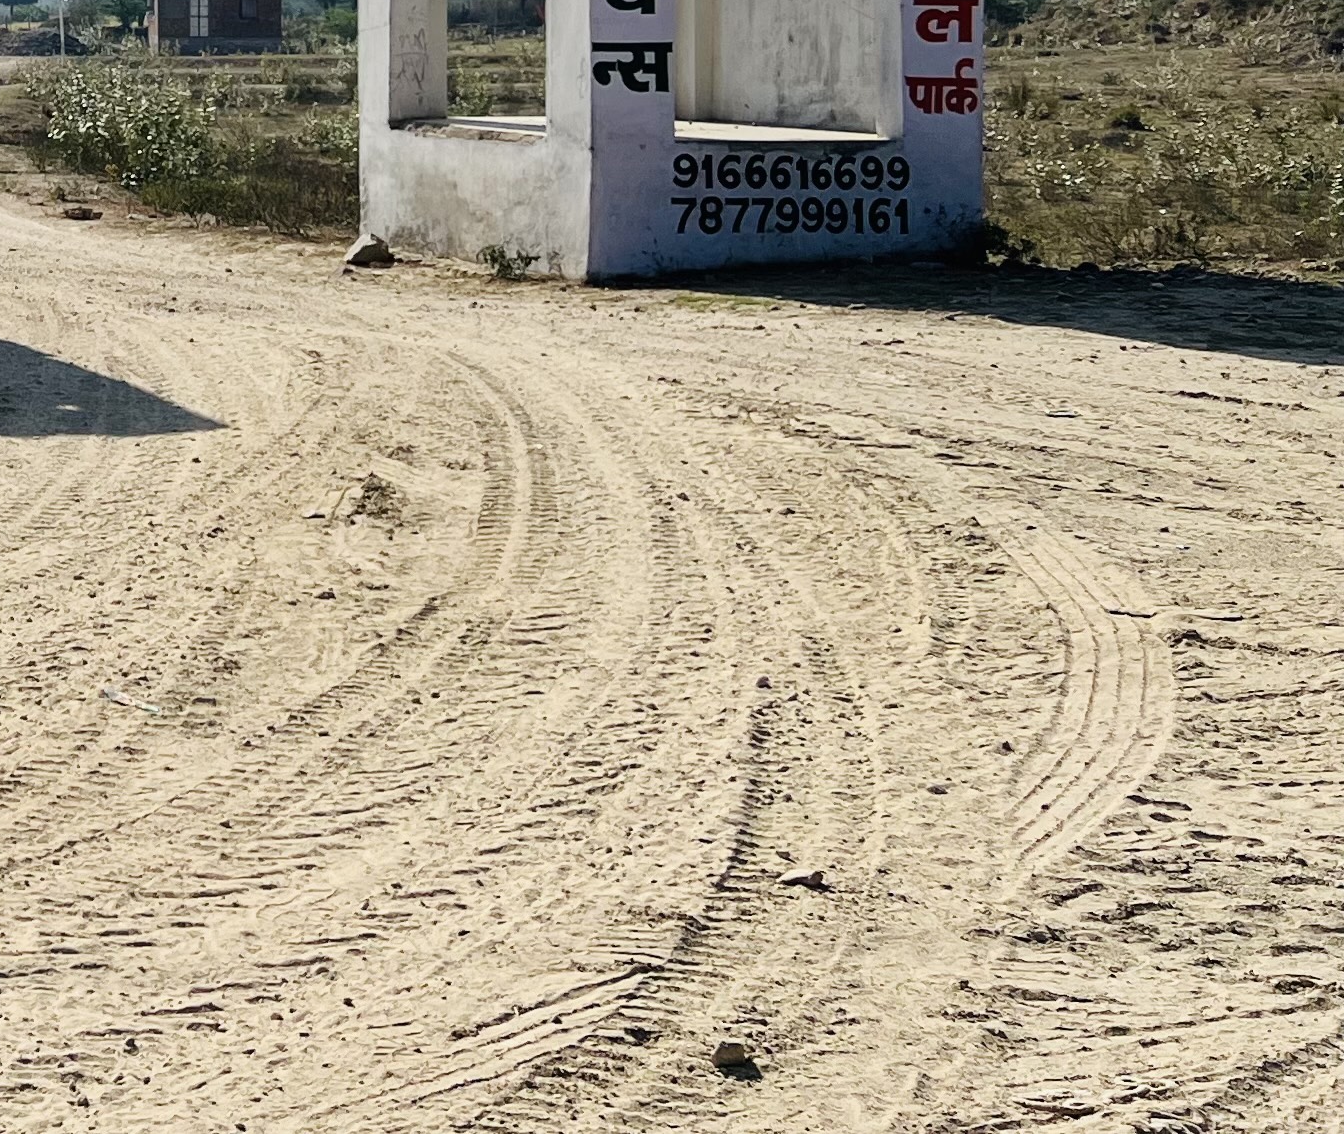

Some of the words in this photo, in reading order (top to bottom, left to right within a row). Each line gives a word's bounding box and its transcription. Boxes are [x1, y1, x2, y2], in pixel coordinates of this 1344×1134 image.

[904, 57, 979, 115] पार्क
[672, 153, 911, 191] 9166616699
[670, 196, 909, 235] 7877999161
